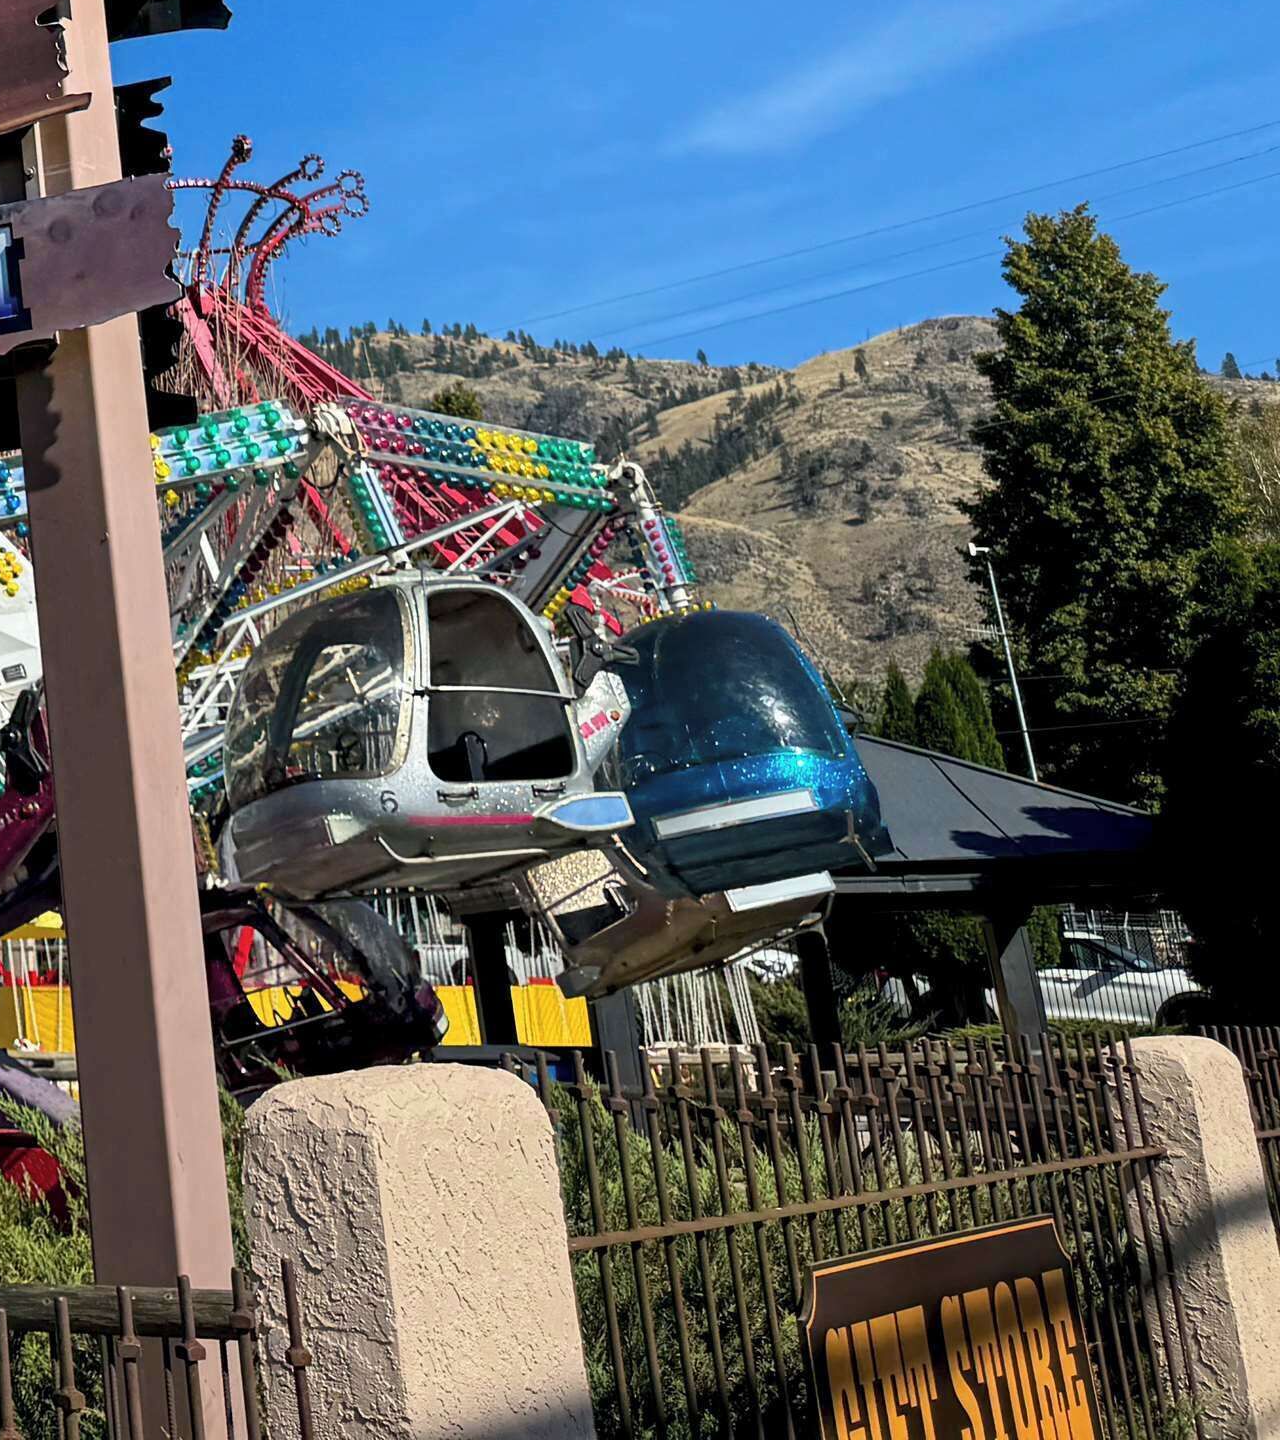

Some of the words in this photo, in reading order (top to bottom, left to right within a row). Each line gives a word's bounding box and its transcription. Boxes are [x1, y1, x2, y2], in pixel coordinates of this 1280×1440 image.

[380, 790, 399, 813] 6
[825, 1304, 937, 1440] GIFT
[940, 1268, 1094, 1440] STORE
